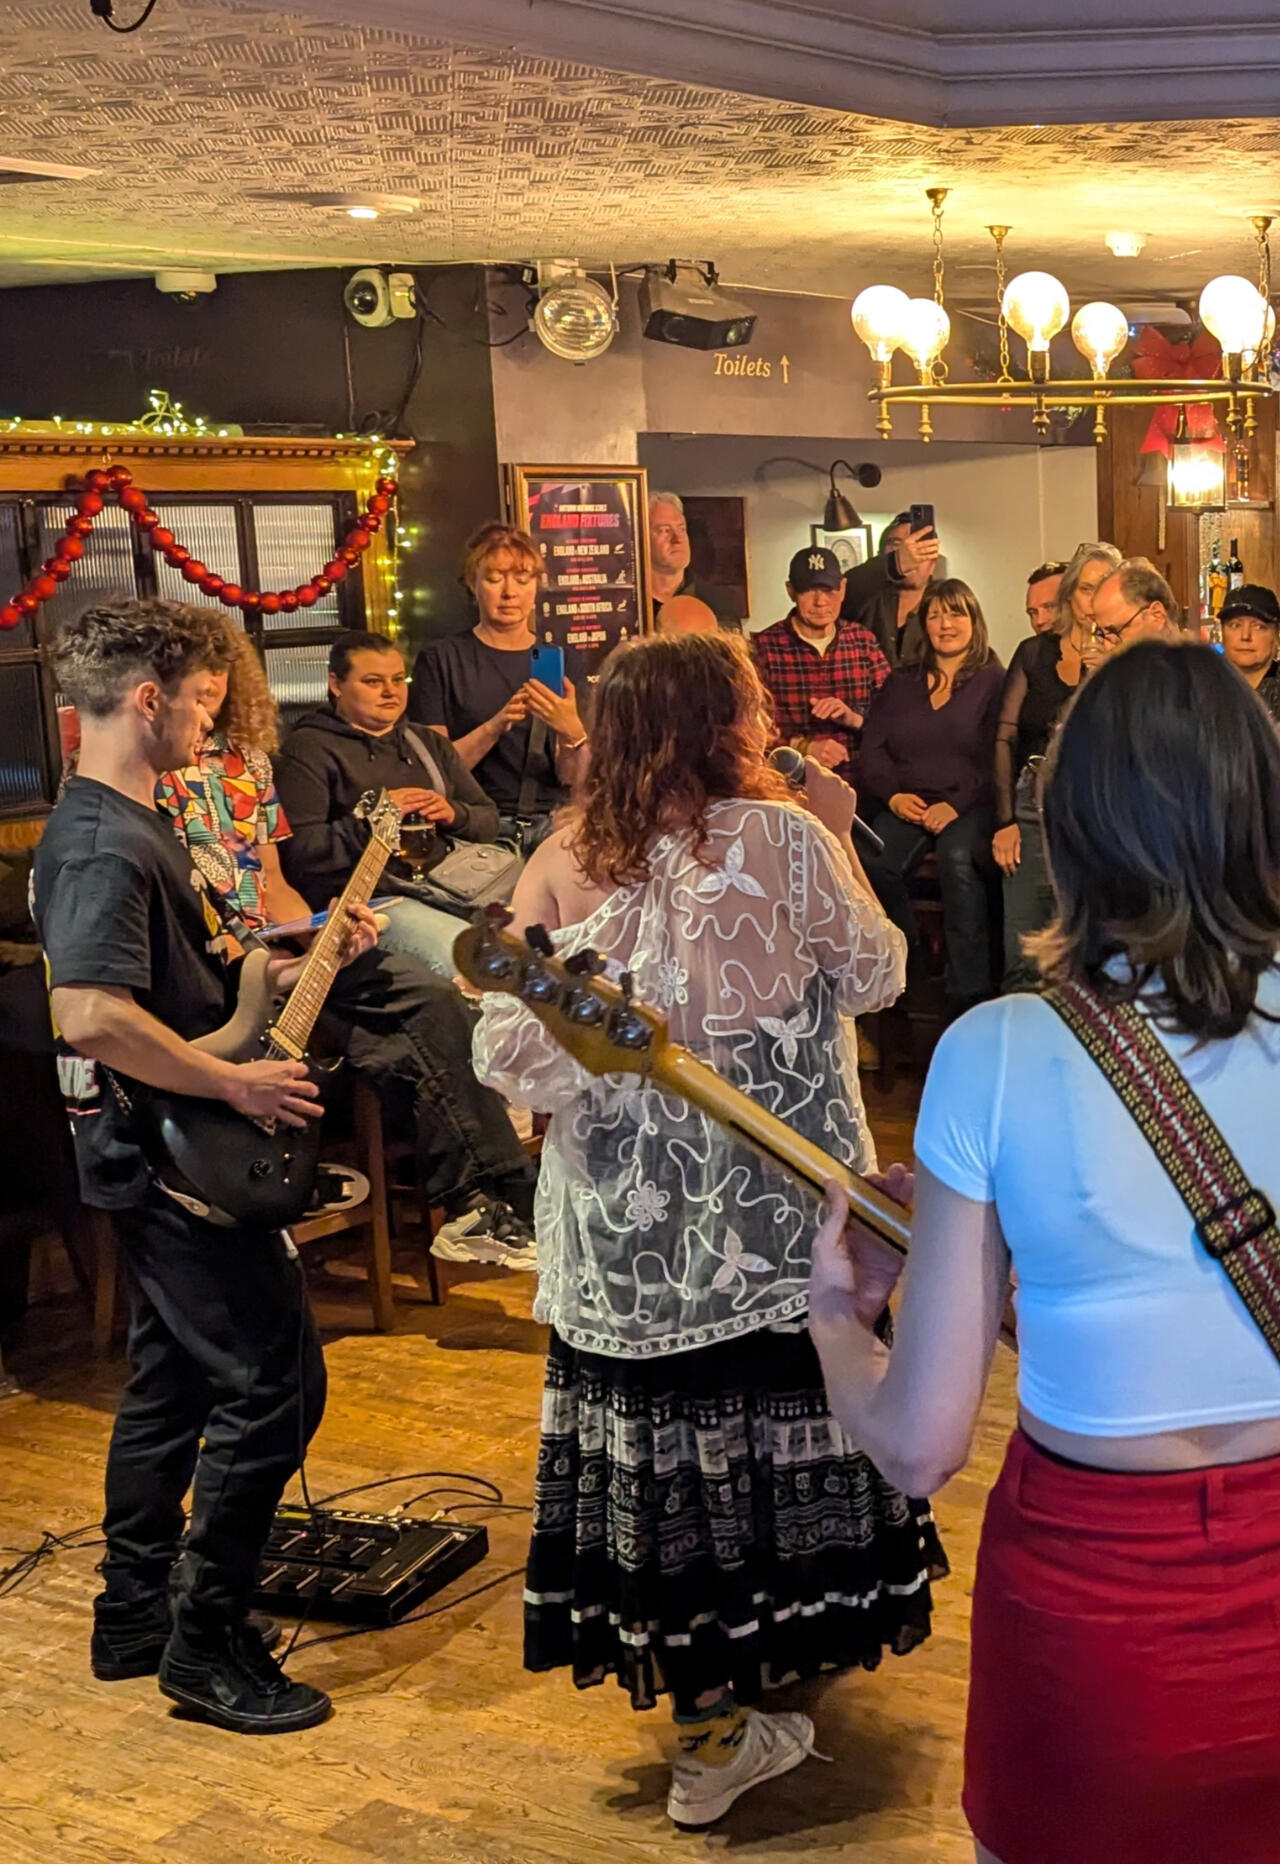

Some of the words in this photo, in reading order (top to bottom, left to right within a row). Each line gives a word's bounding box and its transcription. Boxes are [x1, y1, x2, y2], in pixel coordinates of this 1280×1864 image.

[713, 352, 772, 378] Toilets
[540, 514, 579, 529] ENGLAND
[580, 513, 620, 528] FIXTURES
